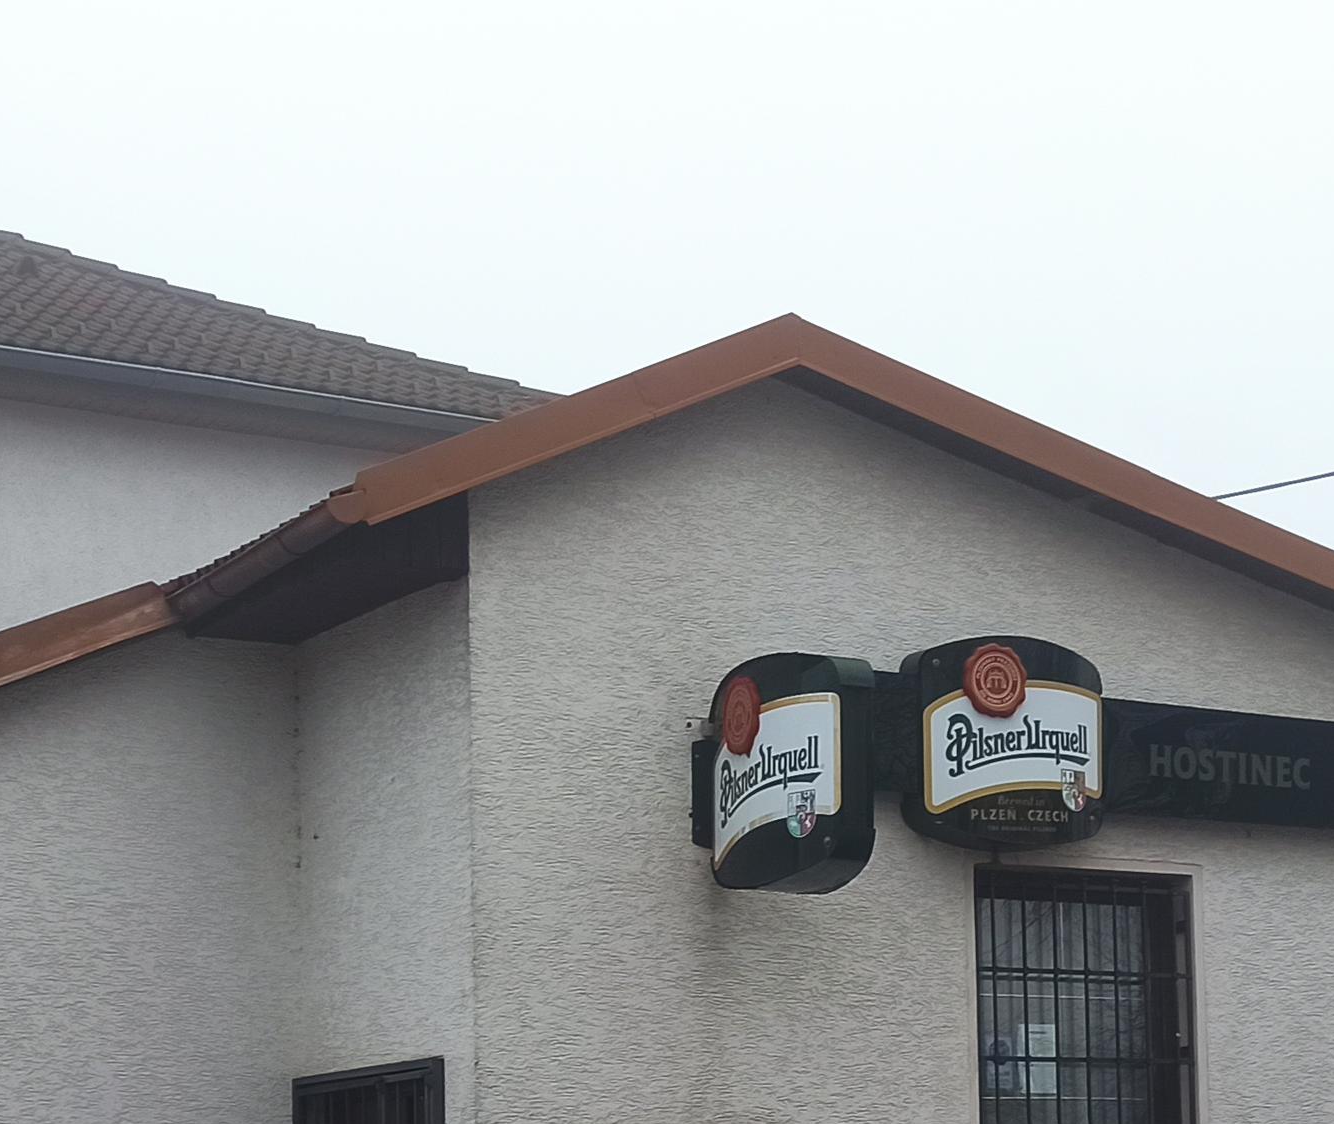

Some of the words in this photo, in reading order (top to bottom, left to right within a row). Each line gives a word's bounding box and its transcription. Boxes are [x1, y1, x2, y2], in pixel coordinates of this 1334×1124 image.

[946, 713, 1027, 777] Pilsner
[1023, 715, 1088, 765] Urquell
[1149, 743, 1311, 790] HOSTINEC
[719, 759, 762, 829] Pilsner
[759, 735, 820, 790] Urquell
[1027, 809, 1069, 823] CZECH
